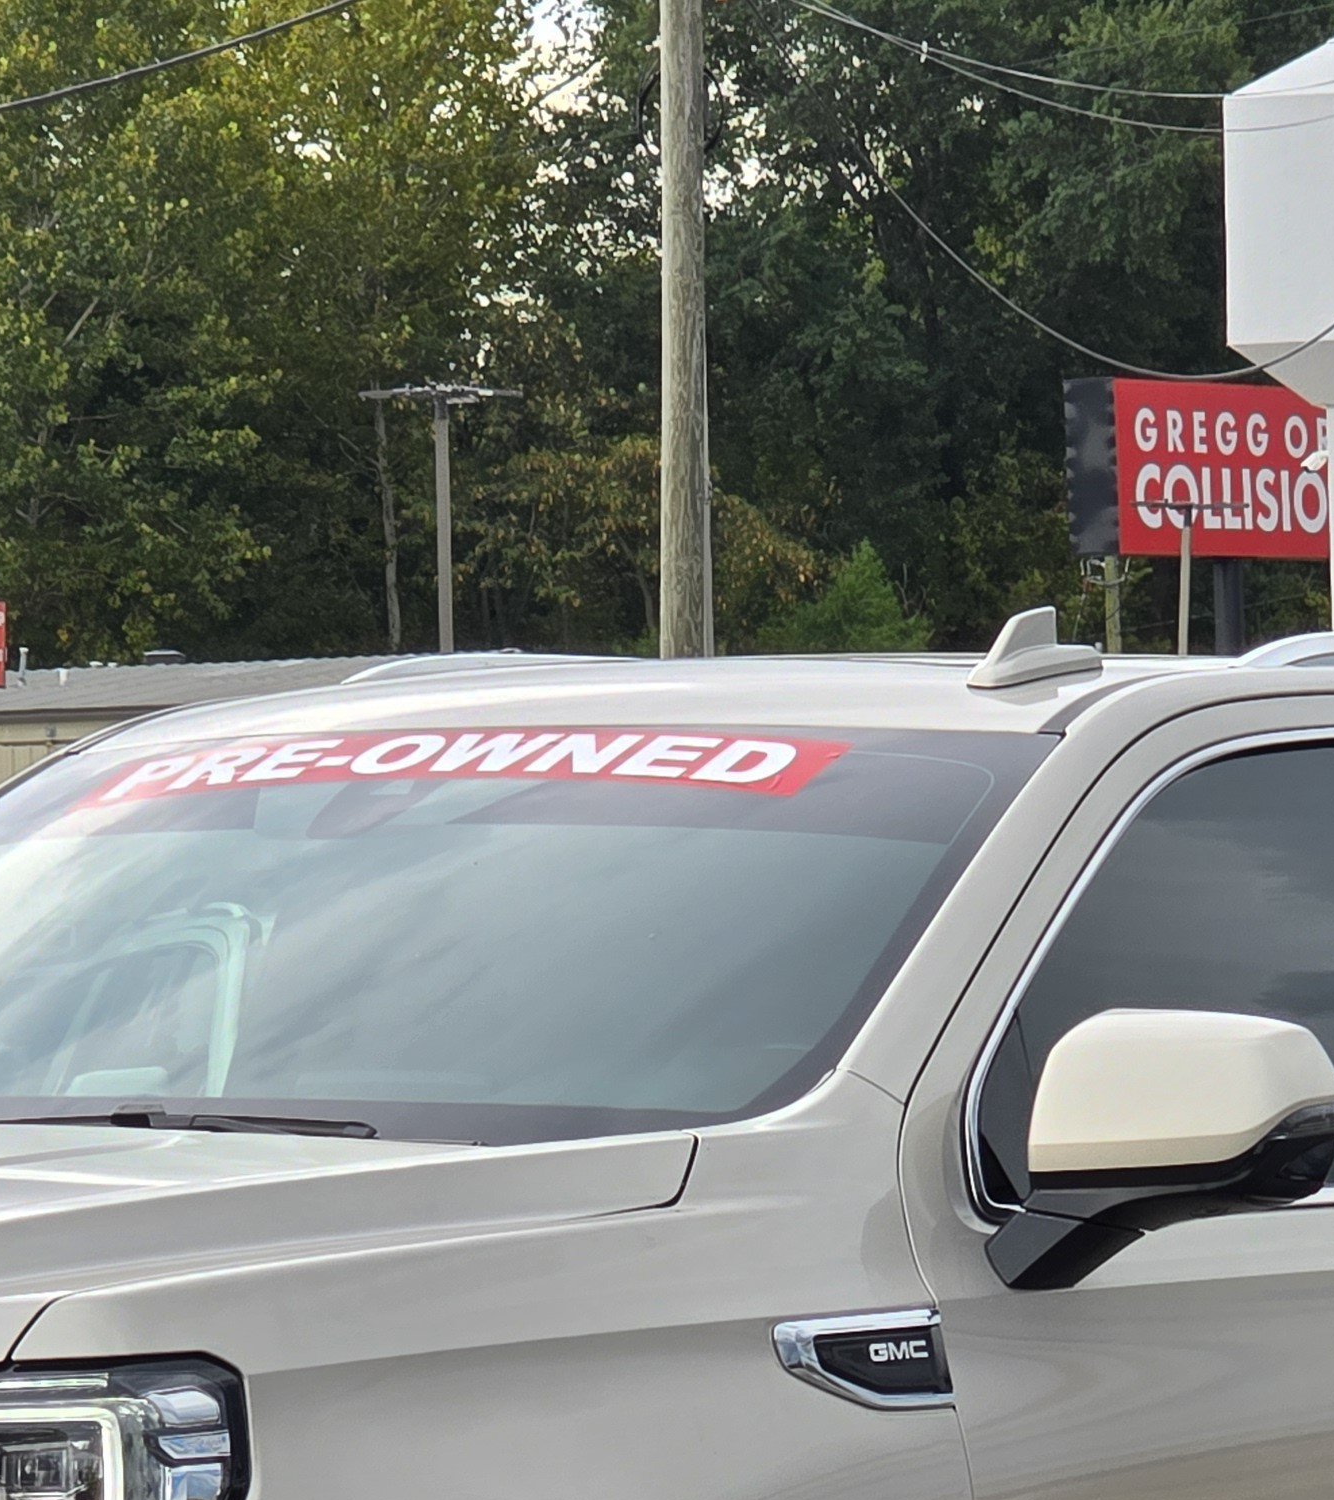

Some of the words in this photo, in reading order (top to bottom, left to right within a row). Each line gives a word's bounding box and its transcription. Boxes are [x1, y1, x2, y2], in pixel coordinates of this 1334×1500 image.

[1134, 407, 1269, 457] GREGG
[1284, 415, 1328, 459] OR
[1135, 463, 1328, 534] COLLISIO
[104, 733, 799, 800] PRE-OWNED
[869, 1340, 929, 1362] GMC
